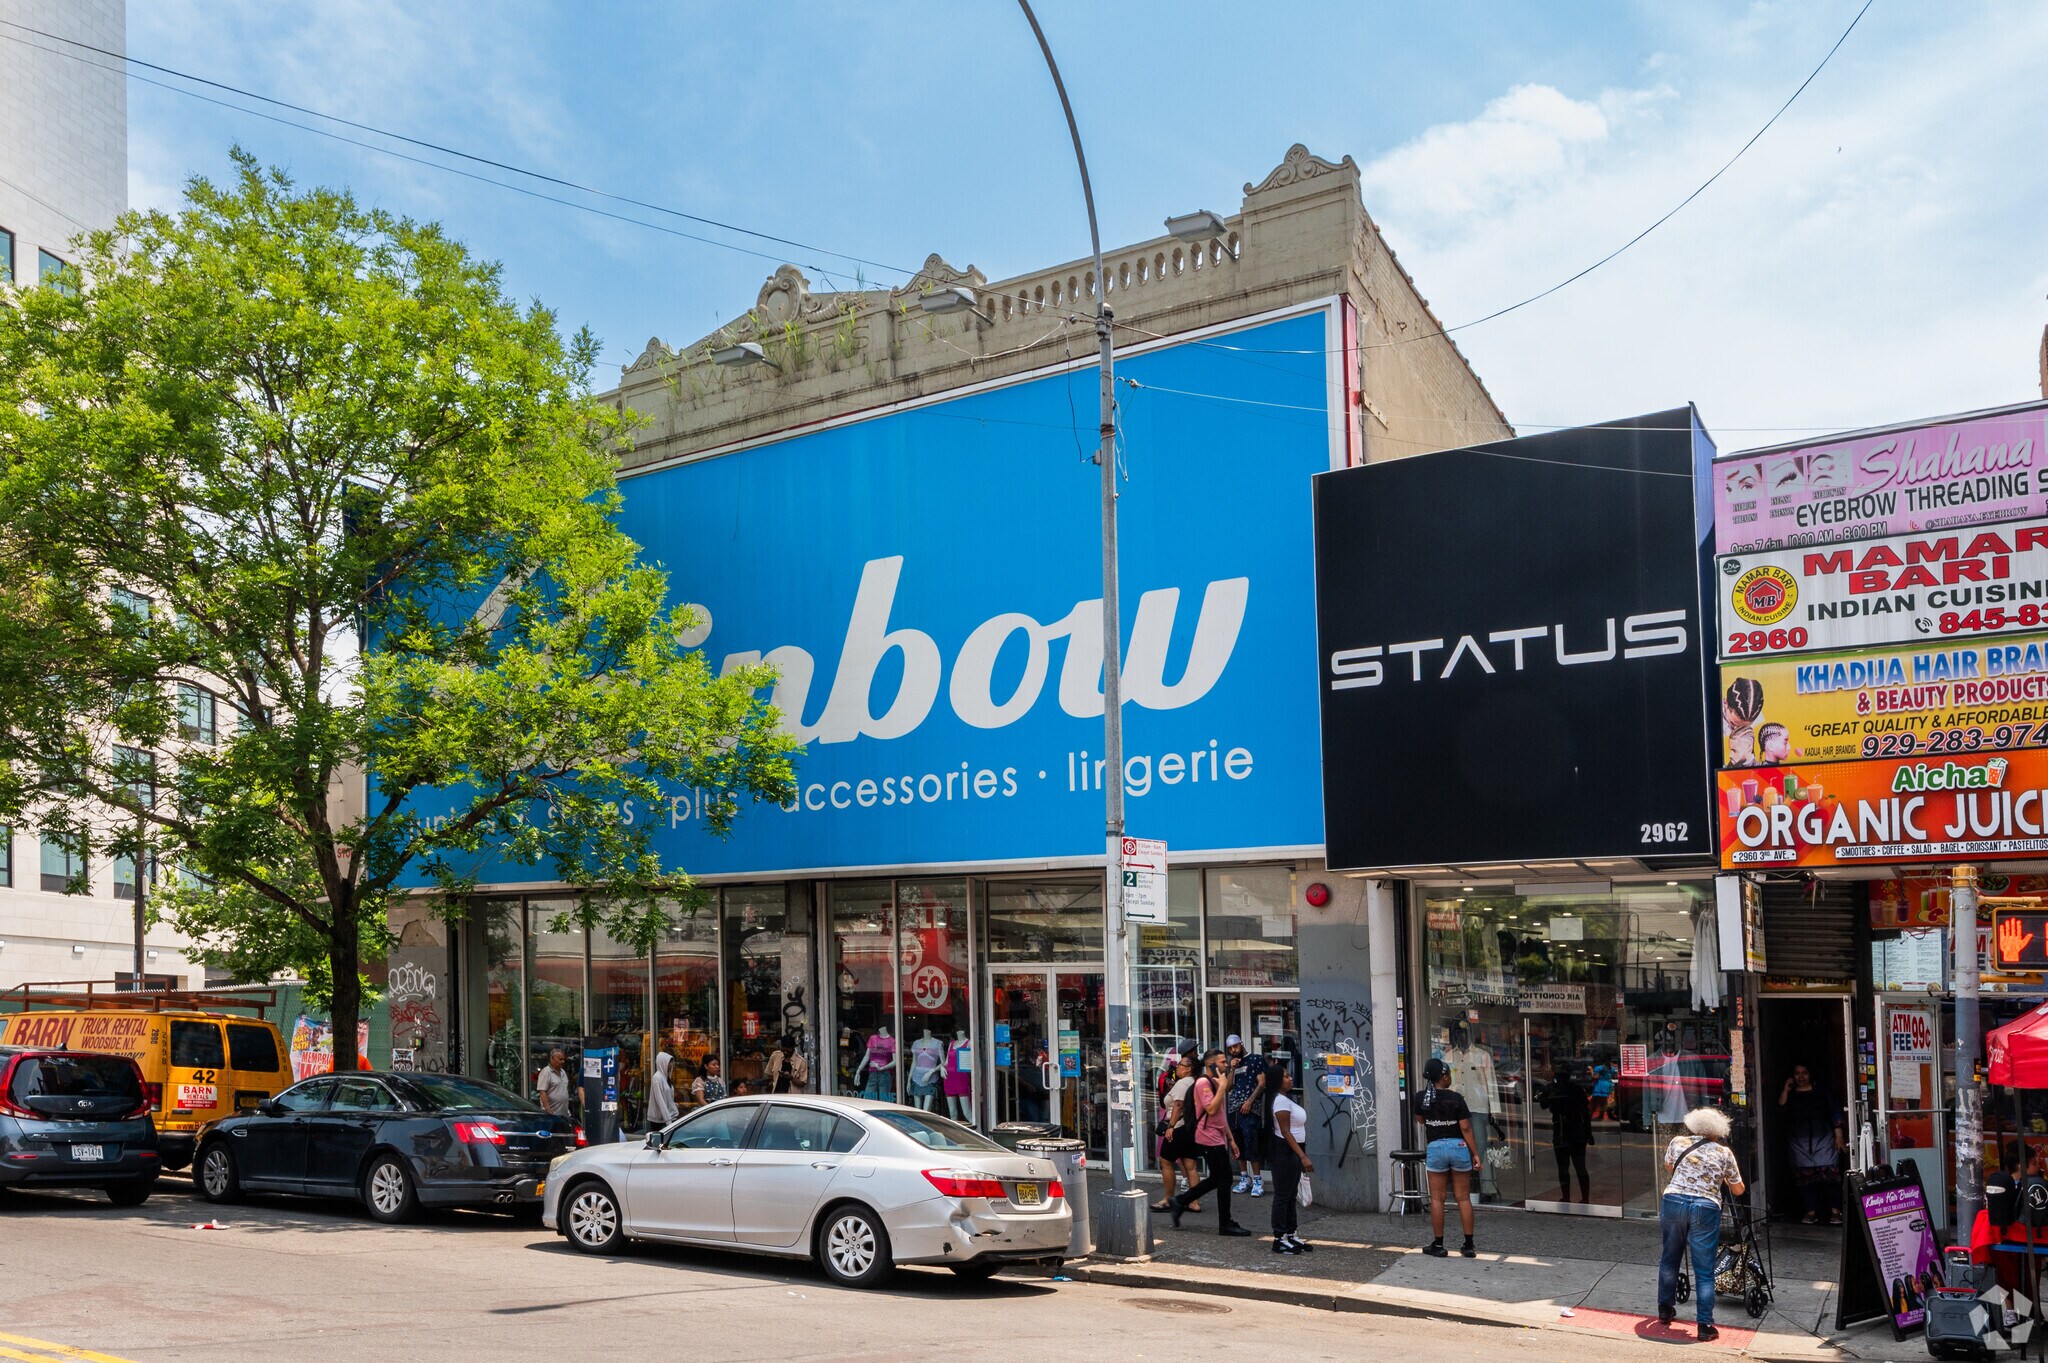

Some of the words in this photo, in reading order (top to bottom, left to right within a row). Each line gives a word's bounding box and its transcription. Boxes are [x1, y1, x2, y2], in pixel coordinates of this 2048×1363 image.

[1851, 431, 2034, 499] Shahana
[1796, 491, 1897, 528] EYEBROW
[1904, 471, 2029, 512] THREADING
[1817, 529, 1834, 544] AM
[1843, 525, 1868, 540] 8:00
[1870, 522, 1888, 537] PM
[1803, 526, 2048, 578] MAMAR
[1736, 567, 1770, 594] MAMAR
[1772, 568, 1794, 590] BARI
[1849, 555, 2011, 595] BARI
[1738, 606, 1762, 622] INDIAN
[1764, 601, 1792, 622] CUISINE
[1753, 596, 1777, 609] MB
[1808, 594, 1915, 622] INDIAN
[1927, 580, 2048, 609] CUISIN
[1331, 609, 1687, 690] STATUS
[1728, 627, 1809, 654] 2960
[1797, 657, 1907, 694] KHADIJA
[1912, 650, 1980, 684] HAIR
[1857, 692, 1870, 713] &
[1876, 685, 1948, 712] BEAUTY
[1863, 715, 1928, 735] QUALITY
[1932, 715, 1942, 728] &
[1945, 706, 2048, 727] AFFORDABLE
[779, 761, 1018, 812] accessories
[1894, 760, 1988, 792] Aicha
[1736, 796, 1927, 848] ORGANIC
[1944, 788, 2048, 839] JUIC
[1640, 822, 1688, 844] 2962
[1738, 852, 1758, 862] 2960
[1774, 850, 1790, 861] AVE.
[1840, 846, 1876, 857] SMOOTHIES
[1882, 845, 1905, 855] COFFEE
[1911, 844, 1932, 854] SALAD
[1940, 842, 1961, 853] BAGEL
[1966, 841, 2002, 852] CROISSANT
[1126, 872, 1134, 886] 2
[12, 1018, 77, 1046] BARN
[80, 1018, 113, 1036] TRUCK
[111, 1018, 148, 1036] RENTAL
[1893, 1014, 1911, 1032] ATM
[122, 1038, 137, 1050] N.Y.
[294, 1034, 308, 1042] MAY
[1894, 1033, 1912, 1051] FEE
[192, 1070, 215, 1084] 42
[1886, 1191, 1897, 1203] Hair
